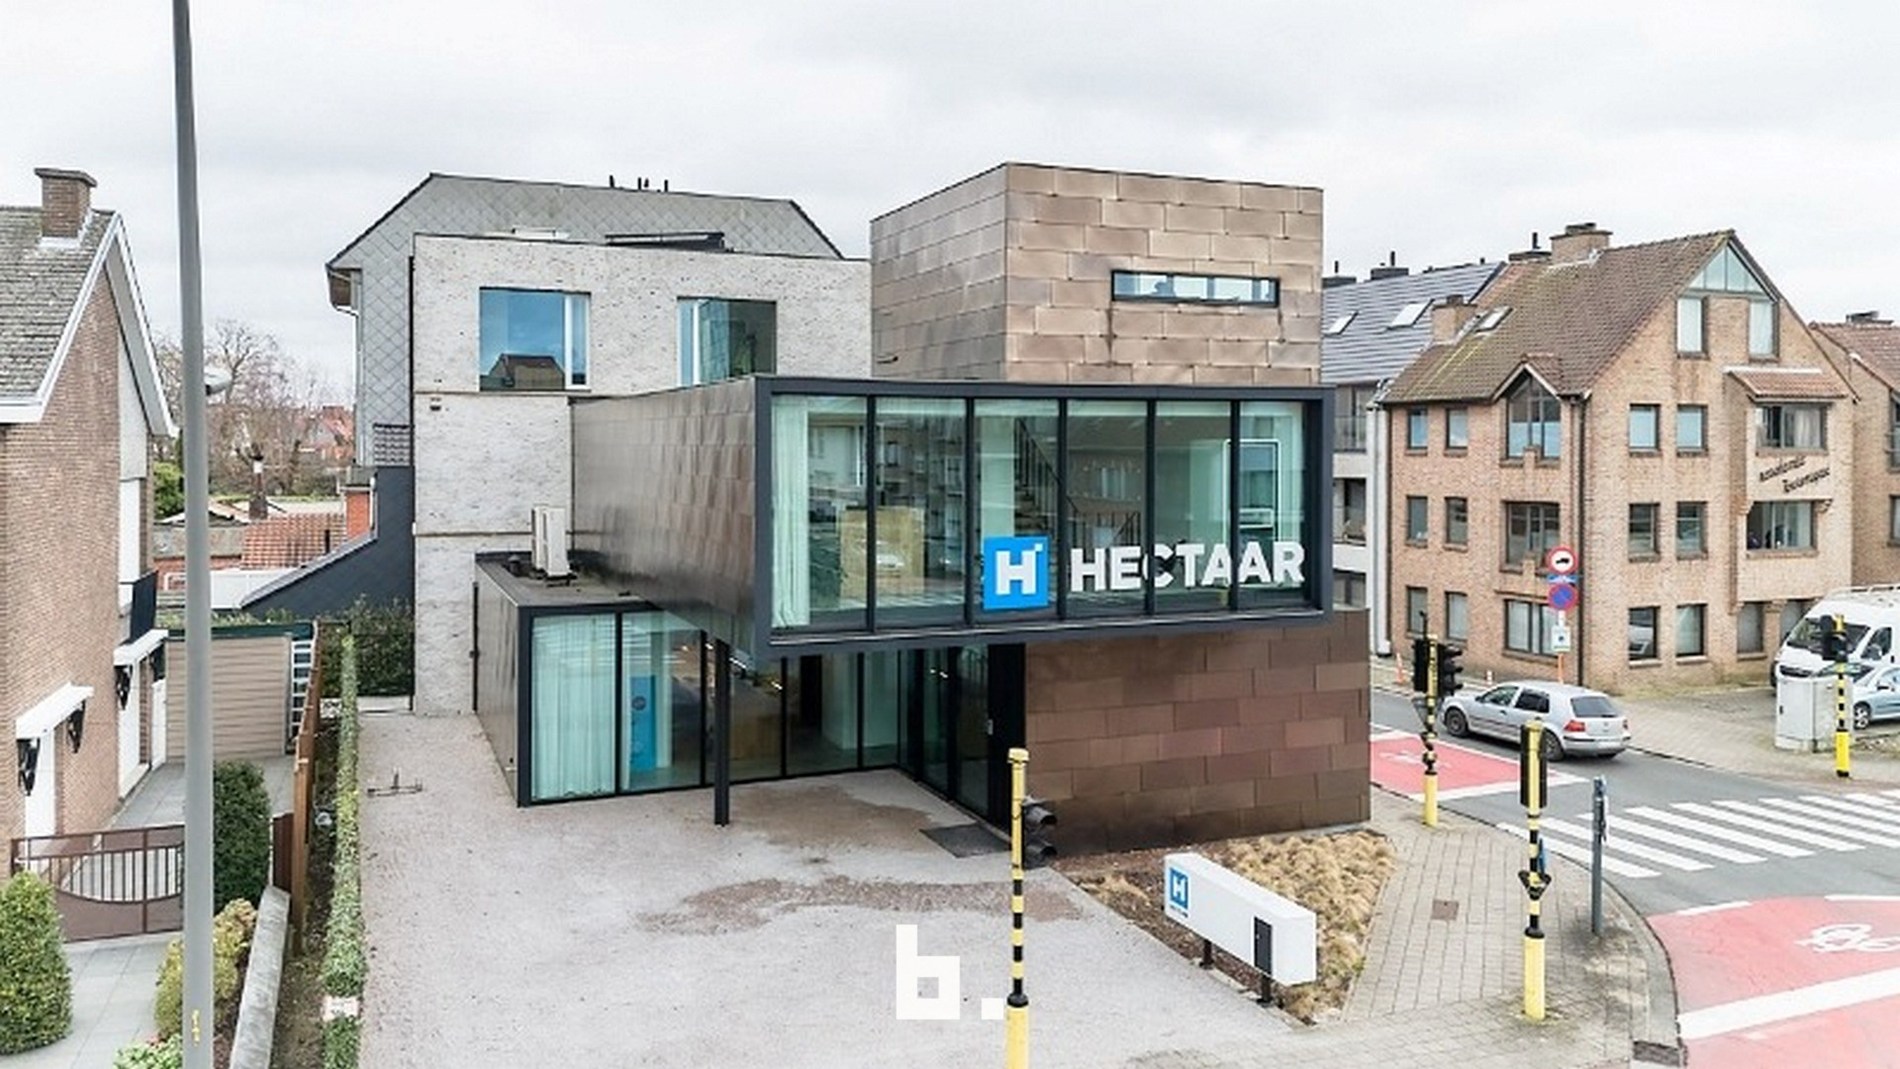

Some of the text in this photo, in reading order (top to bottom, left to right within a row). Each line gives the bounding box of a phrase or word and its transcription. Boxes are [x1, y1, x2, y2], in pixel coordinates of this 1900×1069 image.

[996, 541, 1305, 595] H HECTAAR
[1172, 874, 1186, 902] H
